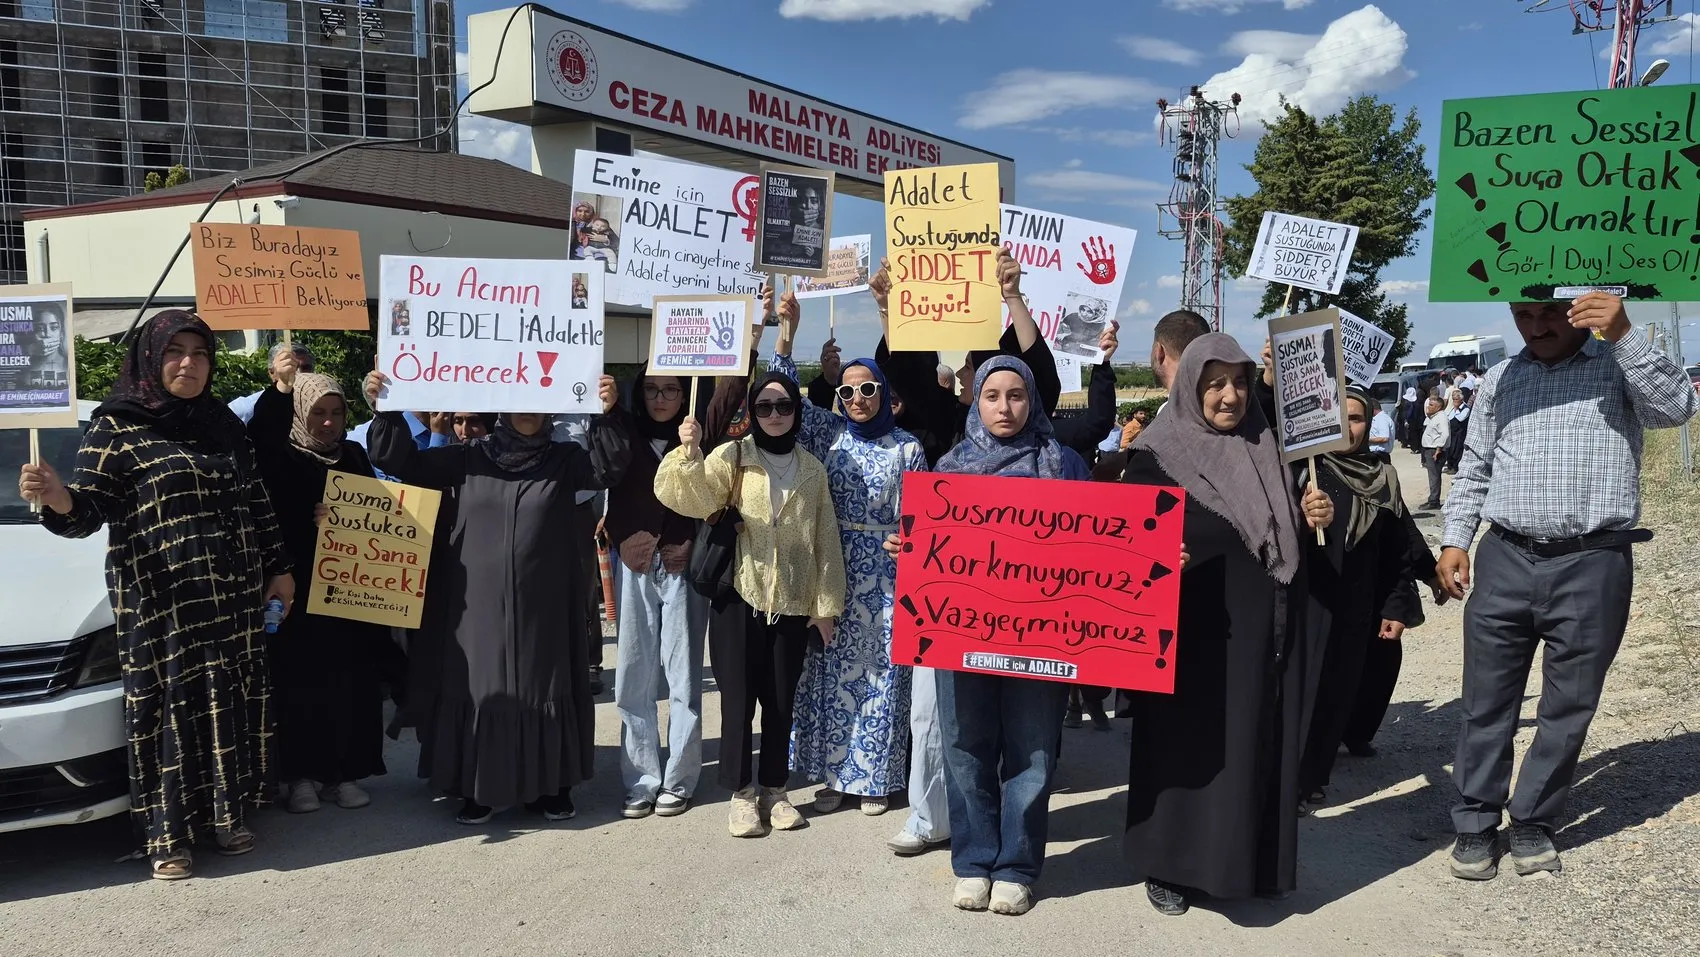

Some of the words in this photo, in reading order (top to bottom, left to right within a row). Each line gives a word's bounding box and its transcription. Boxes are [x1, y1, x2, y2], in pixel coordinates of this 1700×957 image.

[608, 80, 689, 128] CEZA
[695, 104, 860, 171] MAHKEMELERİ
[866, 152, 890, 175] EK
[748, 88, 851, 141] MALATYA
[866, 126, 941, 165] ADLİYESİ
[1454, 111, 1557, 147] Bazen
[1571, 91, 1697, 146] Sessizl
[592, 157, 661, 196] Emine
[676, 186, 705, 204] için
[768, 176, 789, 188] BAZEN
[1487, 152, 1563, 190] Suça
[1577, 150, 1683, 190] Ortak
[768, 186, 798, 198] SESSİZLİK
[890, 172, 973, 206] Adalet
[624, 198, 738, 243] ADALET
[892, 215, 1000, 251] Sustuğunda
[1003, 209, 1064, 243] TININ
[1280, 221, 1337, 240] ADALET
[200, 226, 237, 249] Biz
[250, 226, 340, 262] Buradayız
[633, 237, 670, 260] Kadın
[674, 249, 741, 270] cinayetine
[1274, 234, 1336, 252] SUSTUĞUNDA
[216, 254, 286, 279] Sesimiz
[290, 259, 338, 280] Güçlü
[345, 272, 361, 281] ve
[896, 249, 992, 283] ŞİDDET
[1274, 249, 1323, 267] ŞİDDET
[1496, 244, 1555, 280] Gör!
[1565, 245, 1612, 281] Duy!
[1618, 243, 1657, 270] Ses
[408, 264, 441, 297] Bu
[457, 266, 540, 307] Acının
[625, 259, 669, 283] Adalet
[673, 270, 710, 289] yerini
[717, 276, 764, 300] bulsun!
[205, 280, 286, 306] ADALETİ
[296, 286, 368, 311] Bekliyoruz
[900, 281, 971, 322] Büyür!
[0, 305, 33, 321] USMA
[668, 317, 710, 326] BAHARINDA
[671, 308, 703, 317] HAYATIN
[0, 320, 34, 334] USTUKÇA
[0, 333, 16, 345] IRA
[670, 326, 707, 335] HAYATTAN
[1340, 326, 1366, 342] İDDETTE
[0, 344, 23, 356] ANA
[666, 345, 707, 354] KOPARILDI
[1278, 334, 1316, 360] SUSMA!
[1342, 336, 1365, 354] AYIR!
[0, 355, 31, 366] ELECEK
[660, 354, 693, 365] #EMİNE
[704, 355, 736, 365] ADALET
[1281, 351, 1319, 373] SUSTUKÇA
[1281, 370, 1299, 386] SIRA
[1300, 363, 1320, 379] SANA
[1282, 373, 1325, 402] GELECEK!
[926, 479, 1134, 545] Susmuyoruz,
[322, 529, 358, 556] Sıra
[364, 537, 419, 566] Sana
[318, 556, 425, 598] Gelecek!
[922, 533, 1143, 600] Korkmuyoruz,
[333, 587, 345, 595] Bir
[363, 592, 385, 602] Daha
[924, 595, 1147, 646] Vazgeçmiyoruz
[970, 654, 1010, 670] #EMİNE
[1028, 659, 1070, 677] ADALET
